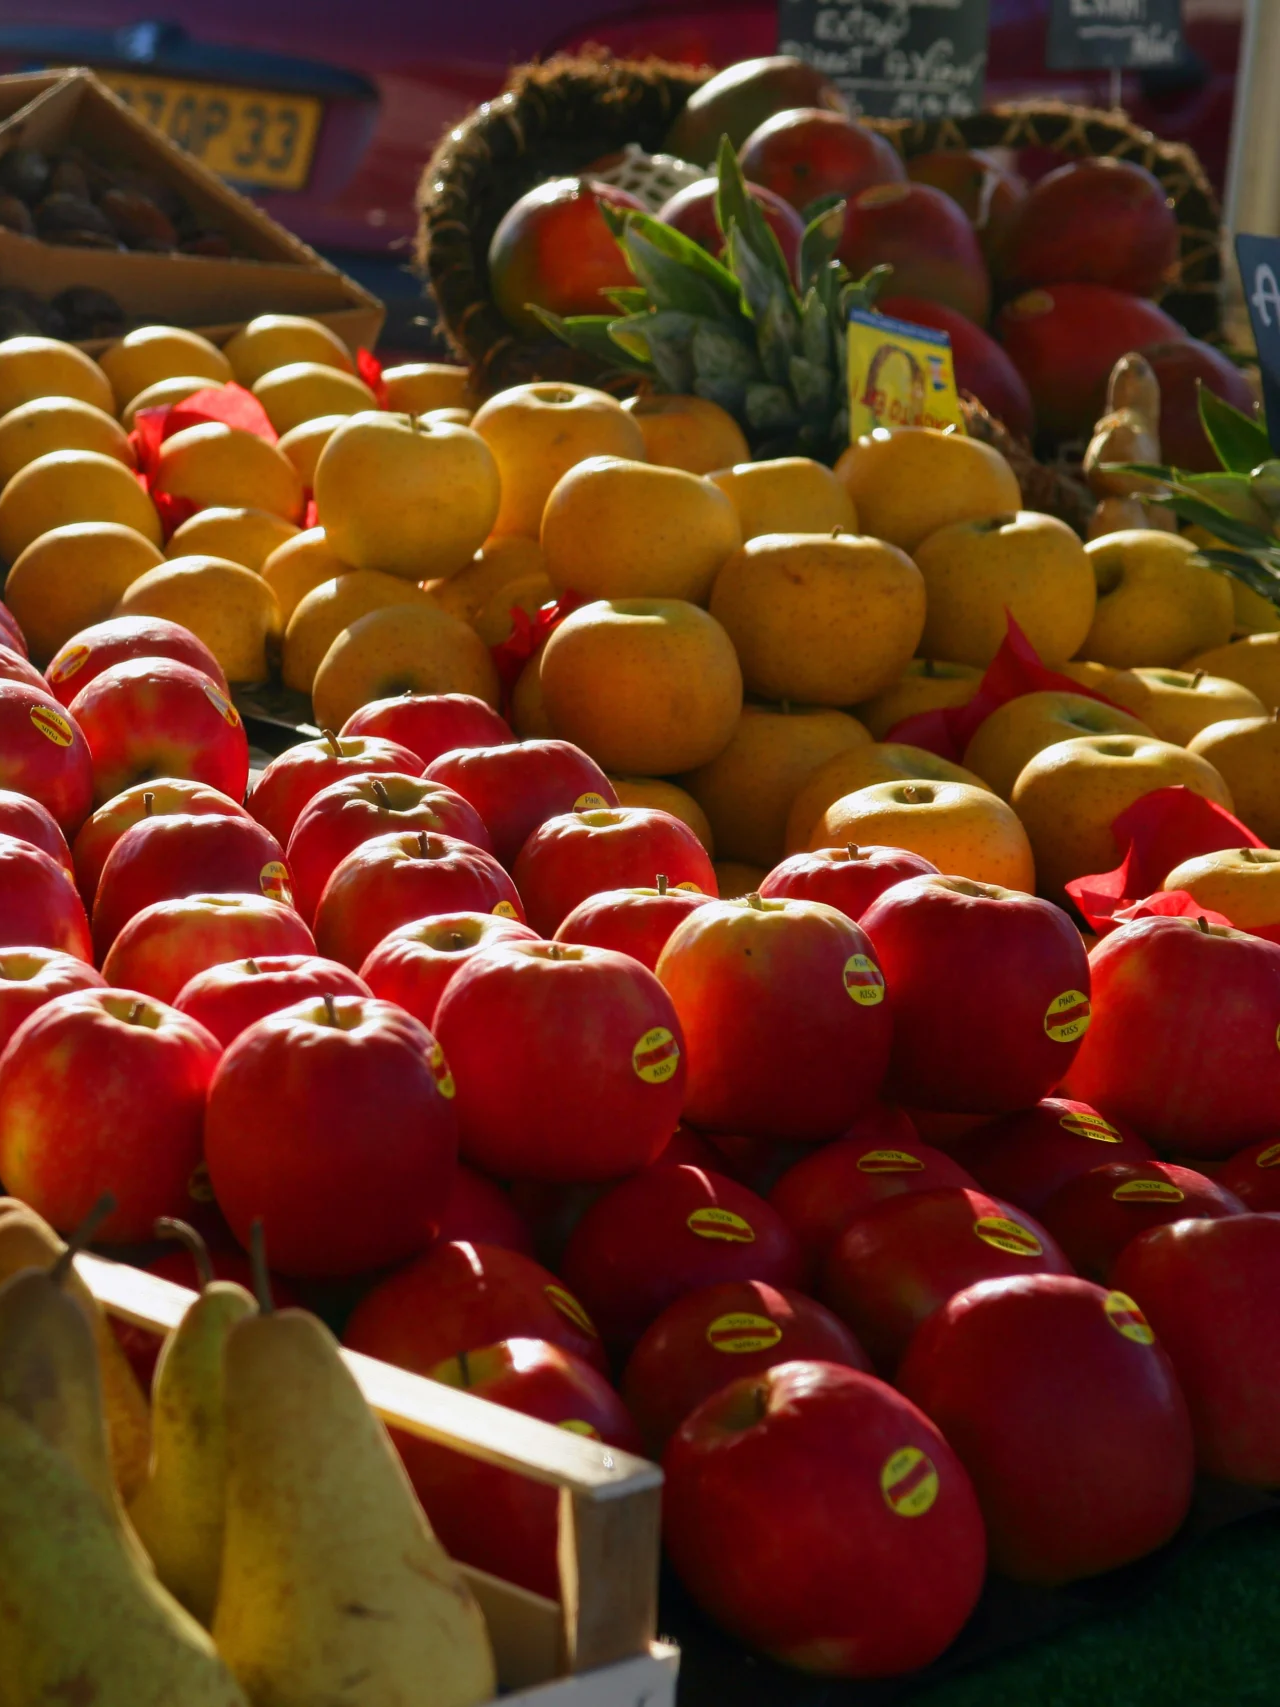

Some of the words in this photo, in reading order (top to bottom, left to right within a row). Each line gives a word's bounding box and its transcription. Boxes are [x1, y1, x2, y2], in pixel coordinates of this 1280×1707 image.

[860, 990, 877, 999] KISS
[1058, 993, 1077, 1008] PINK
[1060, 1024, 1079, 1037] KISS
[645, 1032, 664, 1046] PINK
[652, 1063, 672, 1079] KISS
